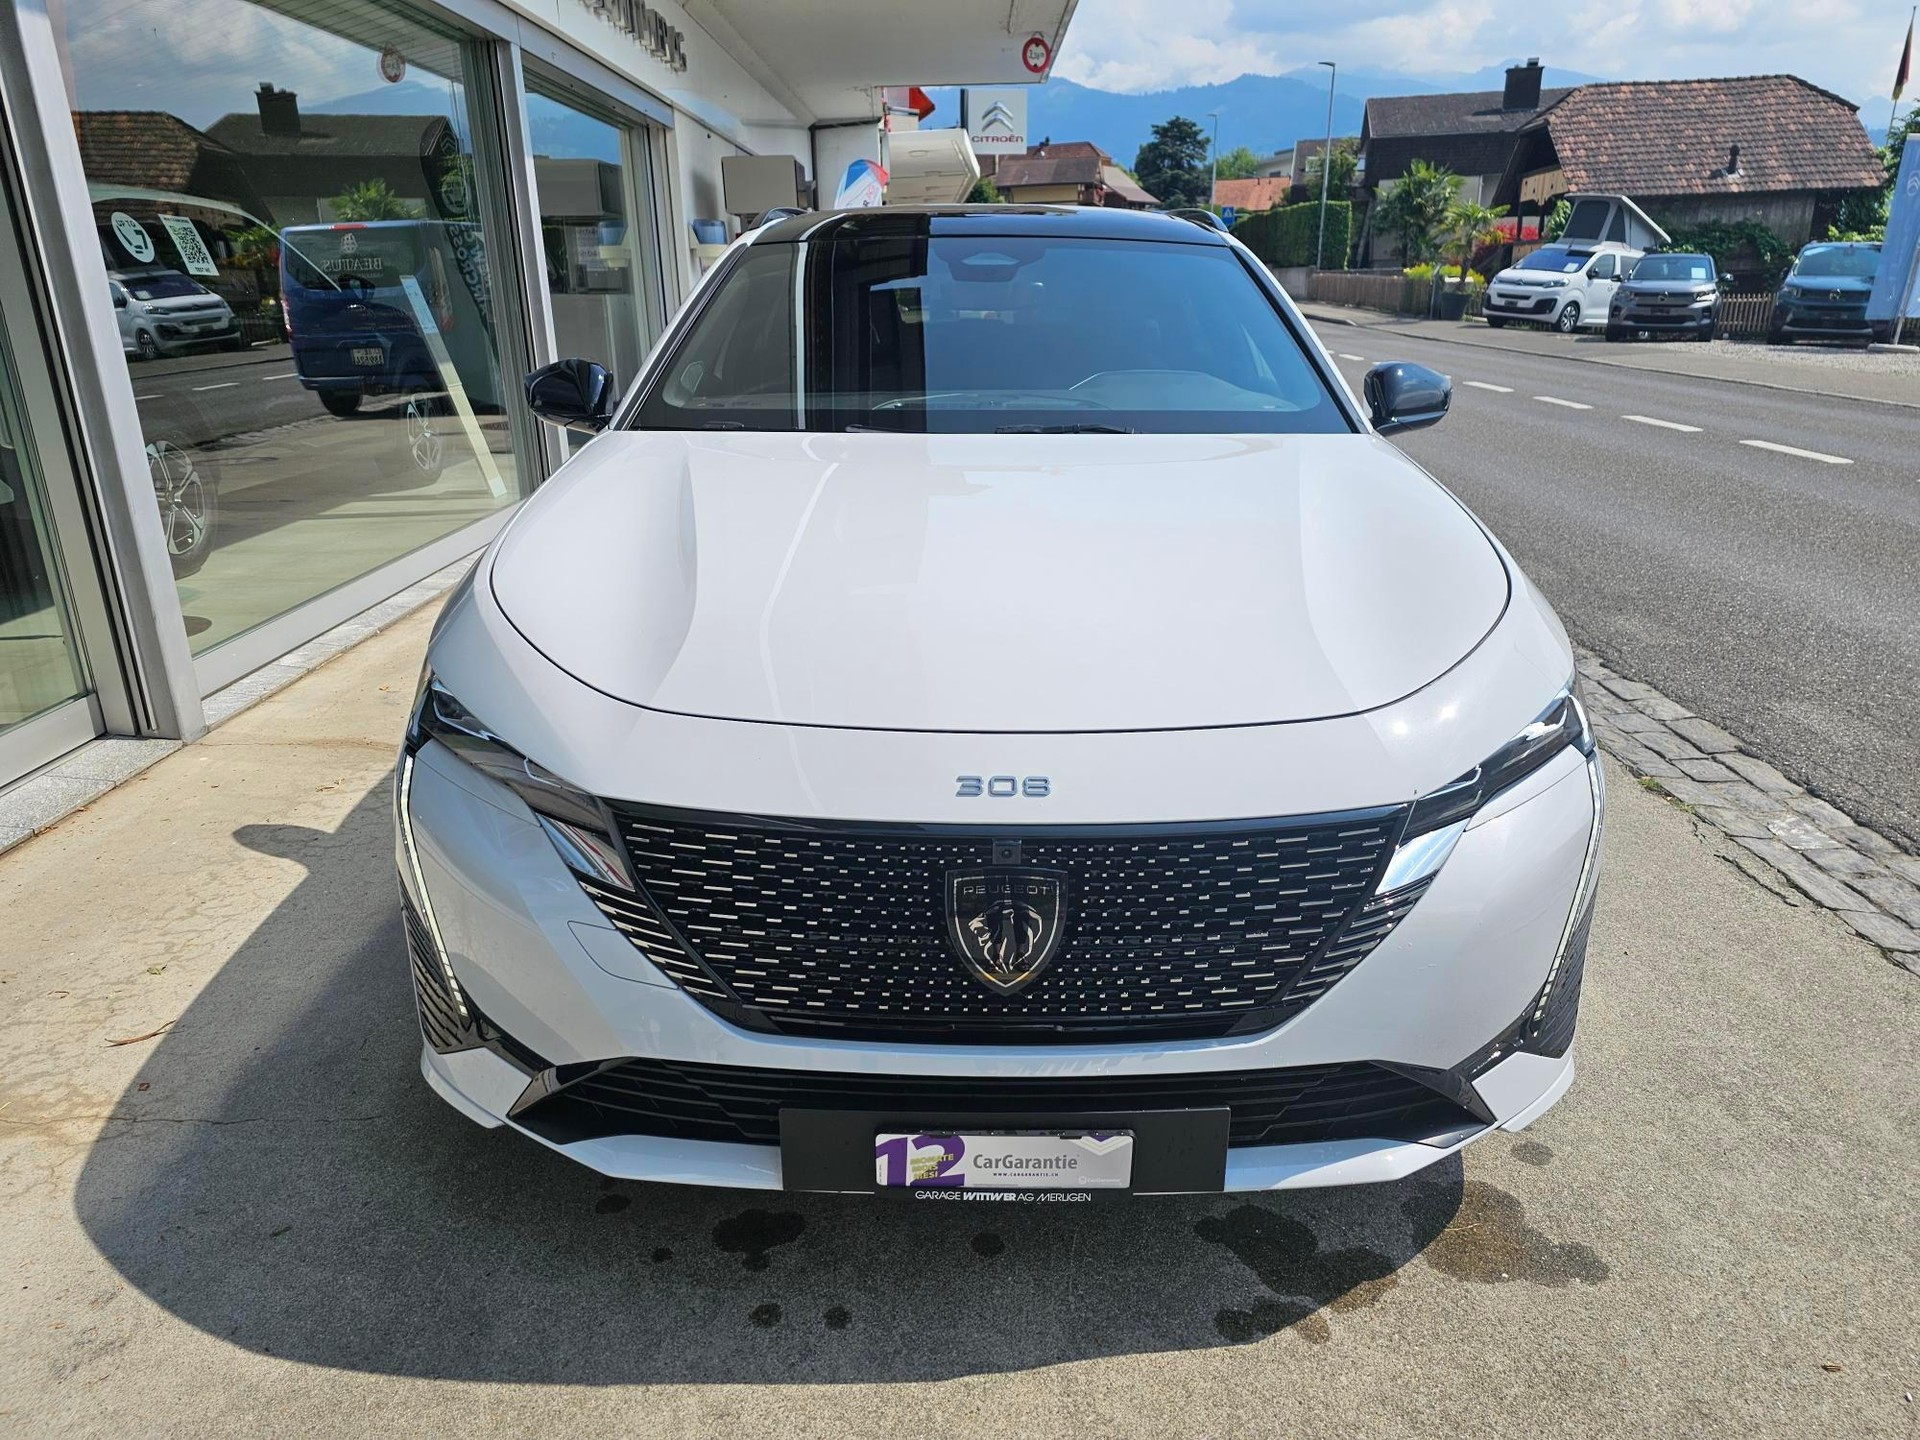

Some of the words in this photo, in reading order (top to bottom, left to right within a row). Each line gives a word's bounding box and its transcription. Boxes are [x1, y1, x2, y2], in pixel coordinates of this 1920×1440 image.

[971, 134, 1024, 143] CITROËN
[955, 775, 1051, 797] 308
[963, 885, 1050, 895] PEUGEOT
[875, 1135, 966, 1187] 12
[973, 1154, 1078, 1169] CarGarantie
[914, 1190, 961, 1200] GARAGE
[963, 1192, 1016, 1201] WITTWER
[1017, 1193, 1035, 1202] AG
